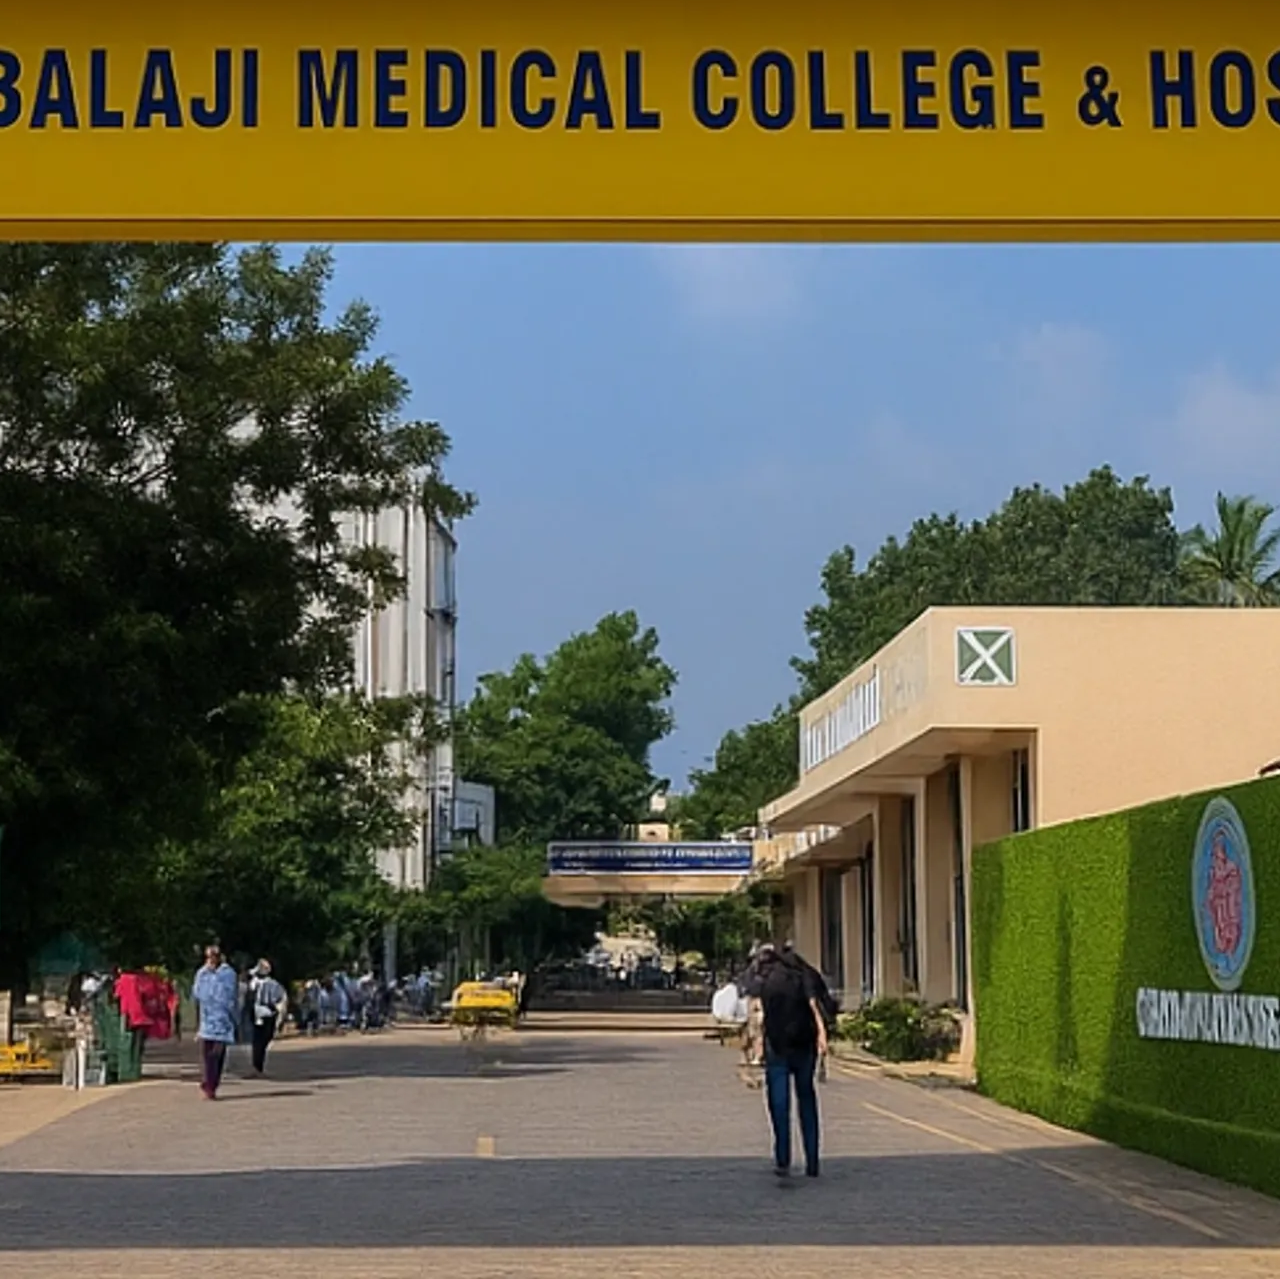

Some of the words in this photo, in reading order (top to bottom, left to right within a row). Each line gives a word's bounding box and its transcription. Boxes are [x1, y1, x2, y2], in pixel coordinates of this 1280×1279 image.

[296, 48, 662, 130] MEDICAL
[691, 48, 1045, 131] COLLEGE
[1077, 65, 1124, 128] &
